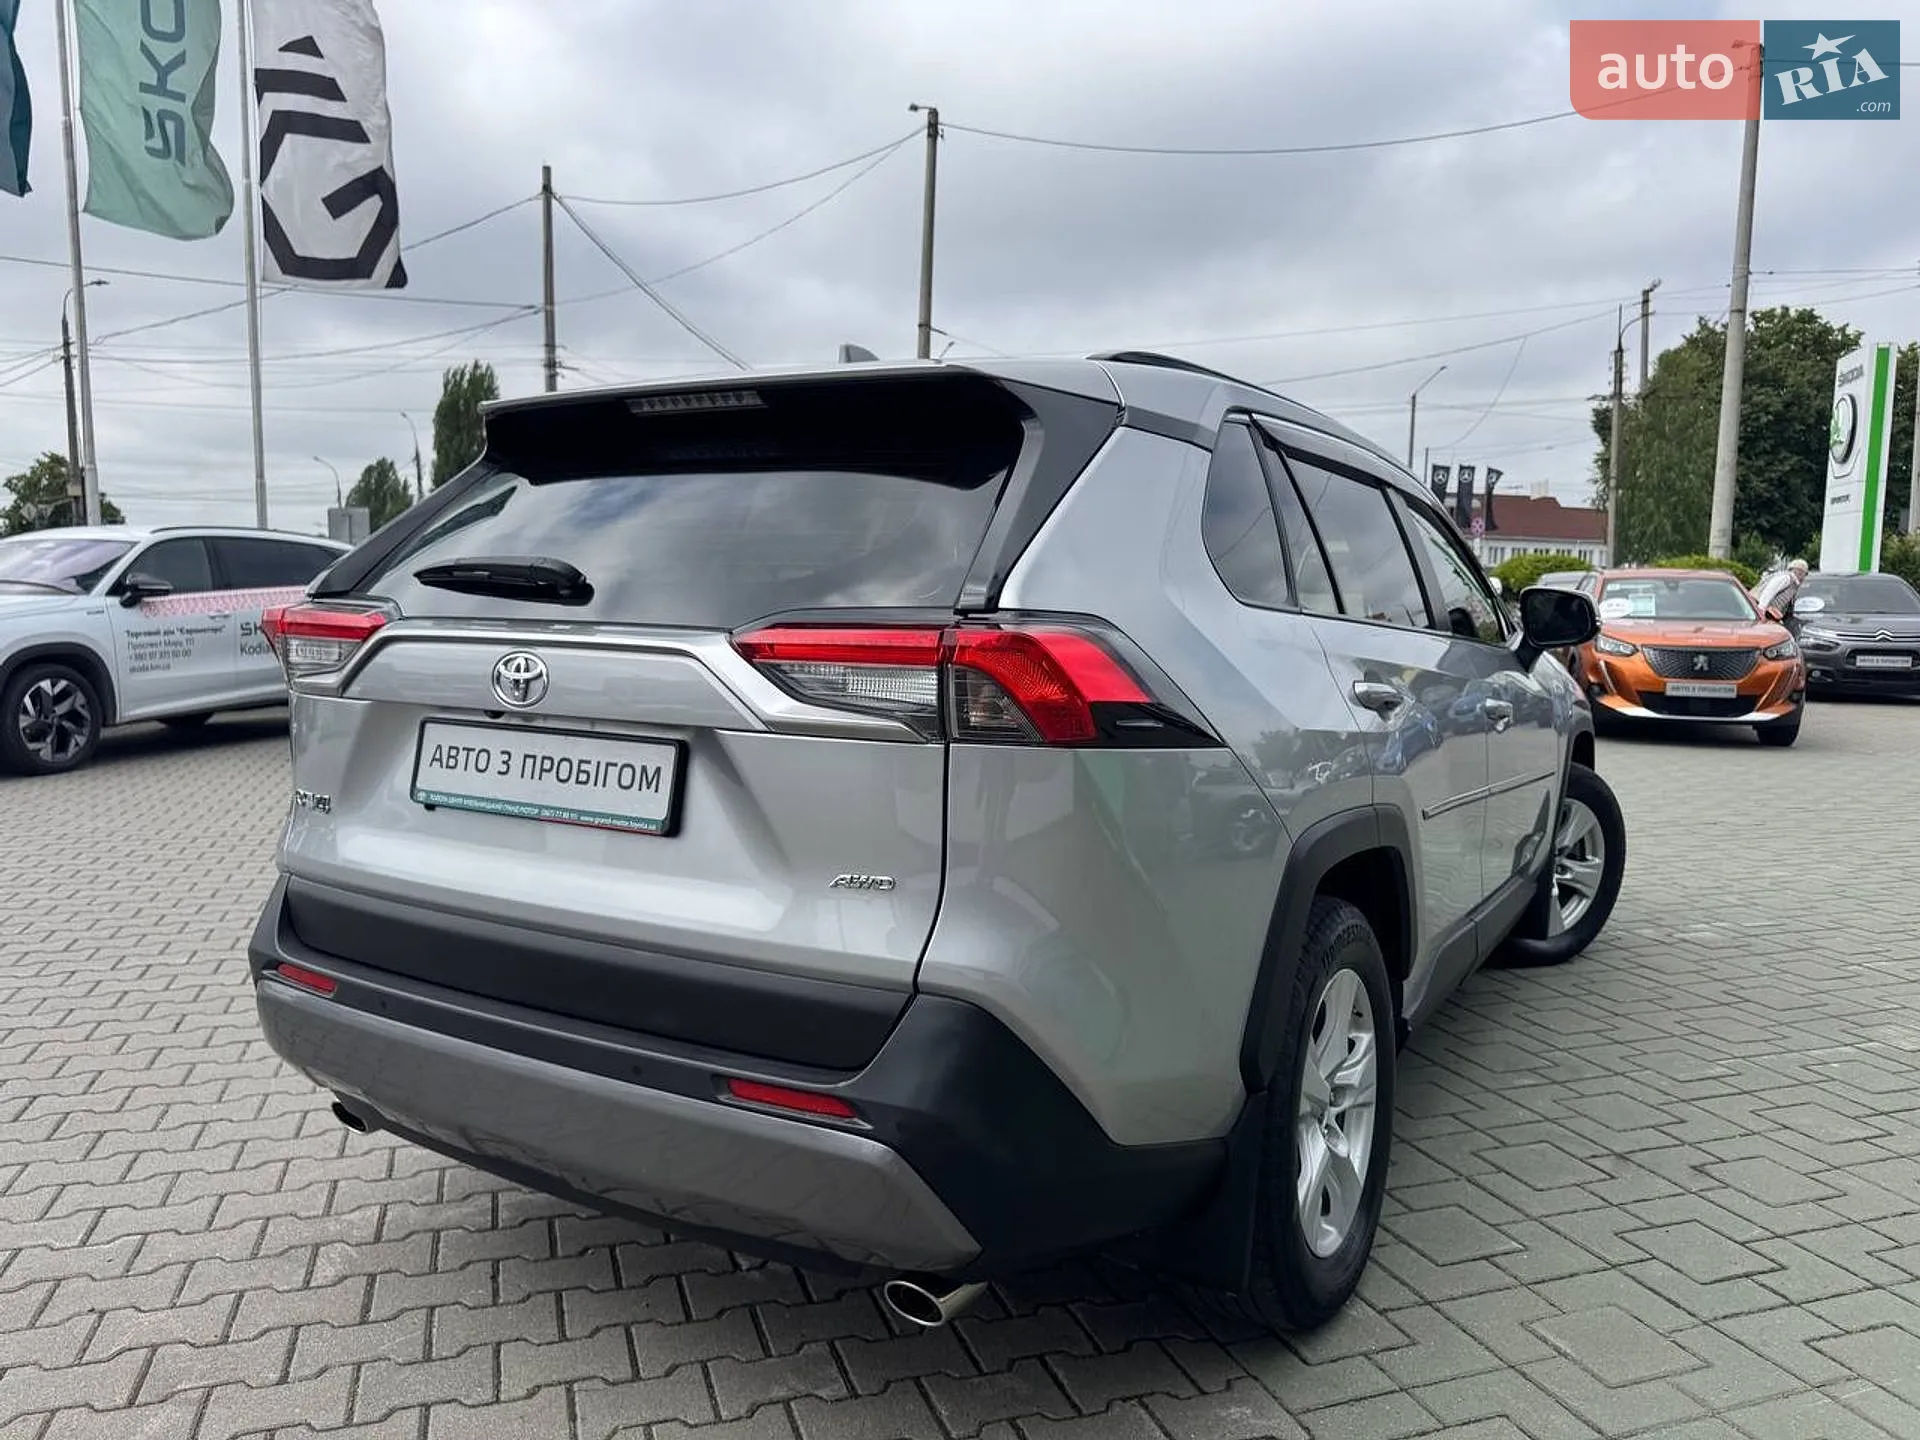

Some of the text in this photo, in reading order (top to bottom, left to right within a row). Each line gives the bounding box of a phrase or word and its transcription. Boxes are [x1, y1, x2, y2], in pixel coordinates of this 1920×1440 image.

[429, 744, 491, 773] АВТО
[520, 753, 662, 793] ПРОБІГОМ
[828, 874, 897, 890] AWD
